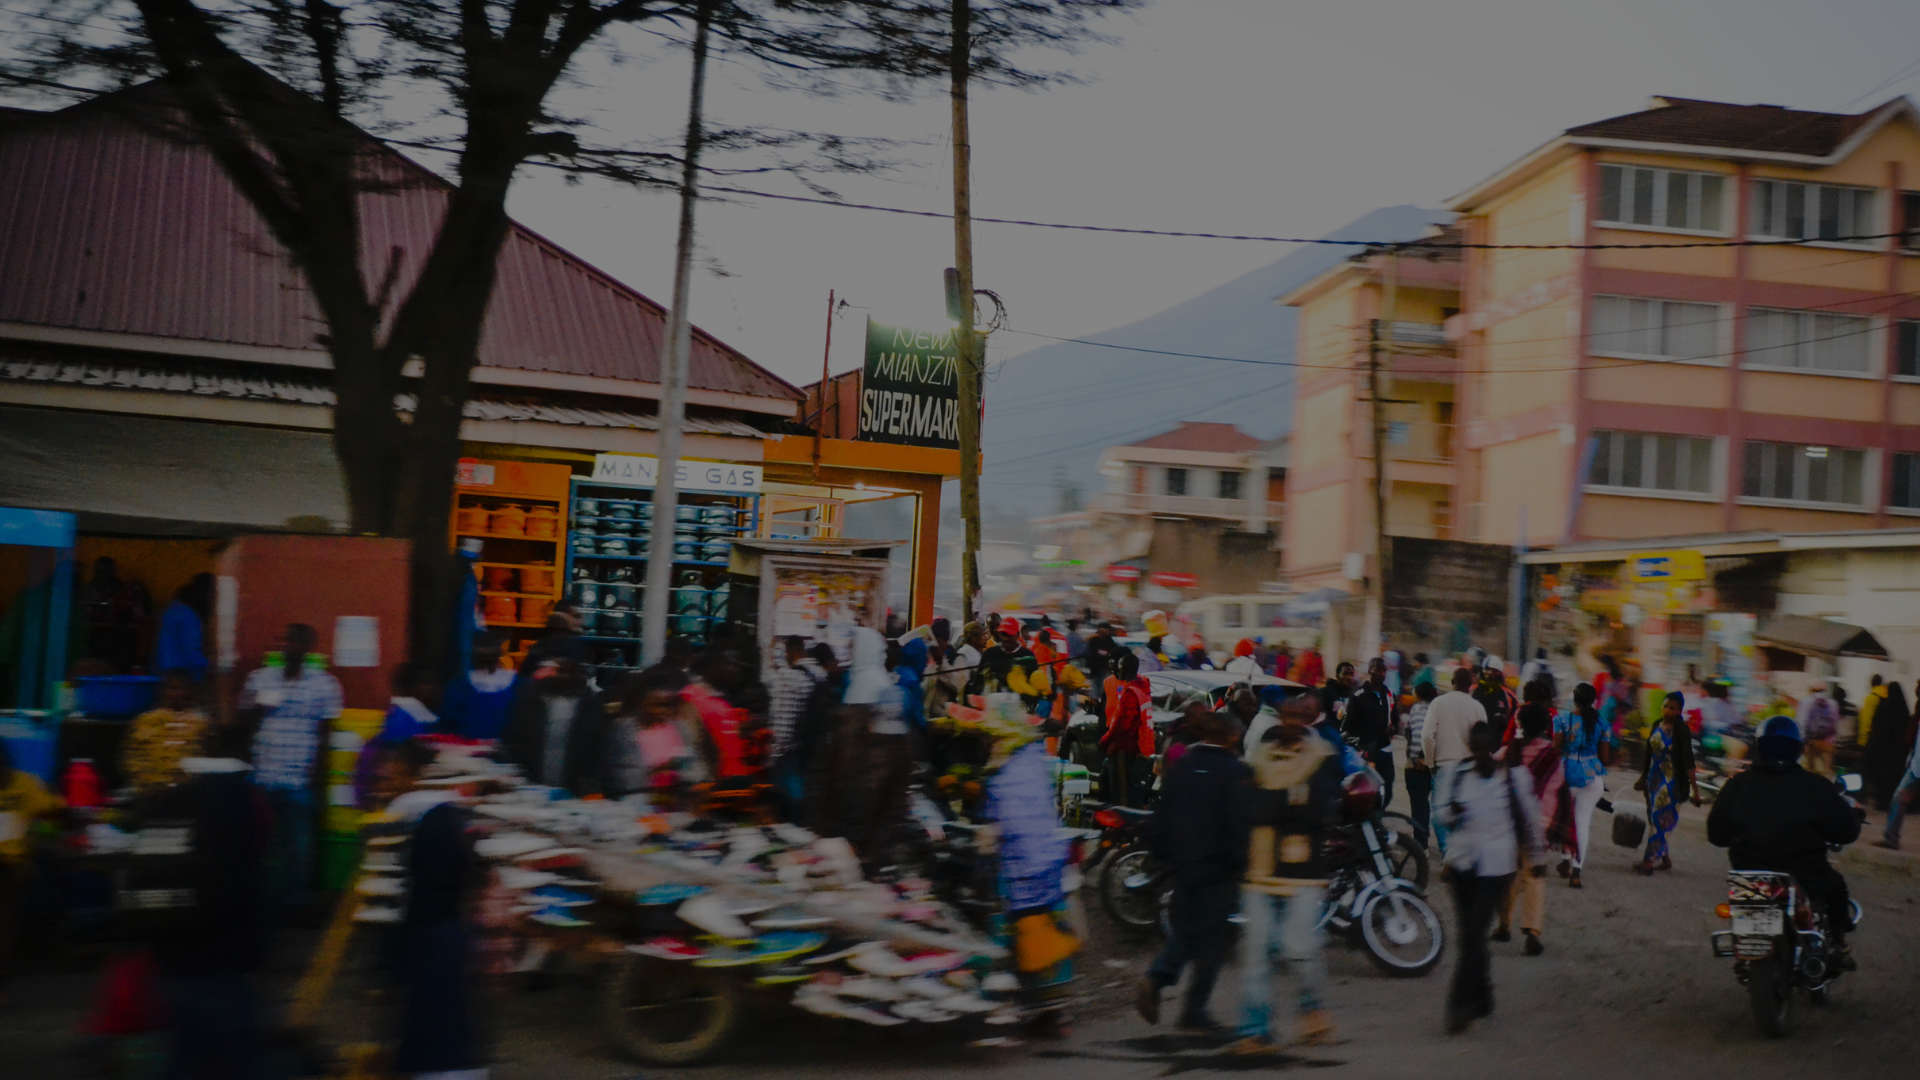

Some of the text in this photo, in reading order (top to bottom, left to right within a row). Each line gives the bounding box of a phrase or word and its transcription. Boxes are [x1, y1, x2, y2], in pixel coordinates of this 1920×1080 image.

[893, 324, 952, 351] NEW
[861, 388, 979, 442] SUPERMARK
[600, 460, 755, 487] MANS GAS
